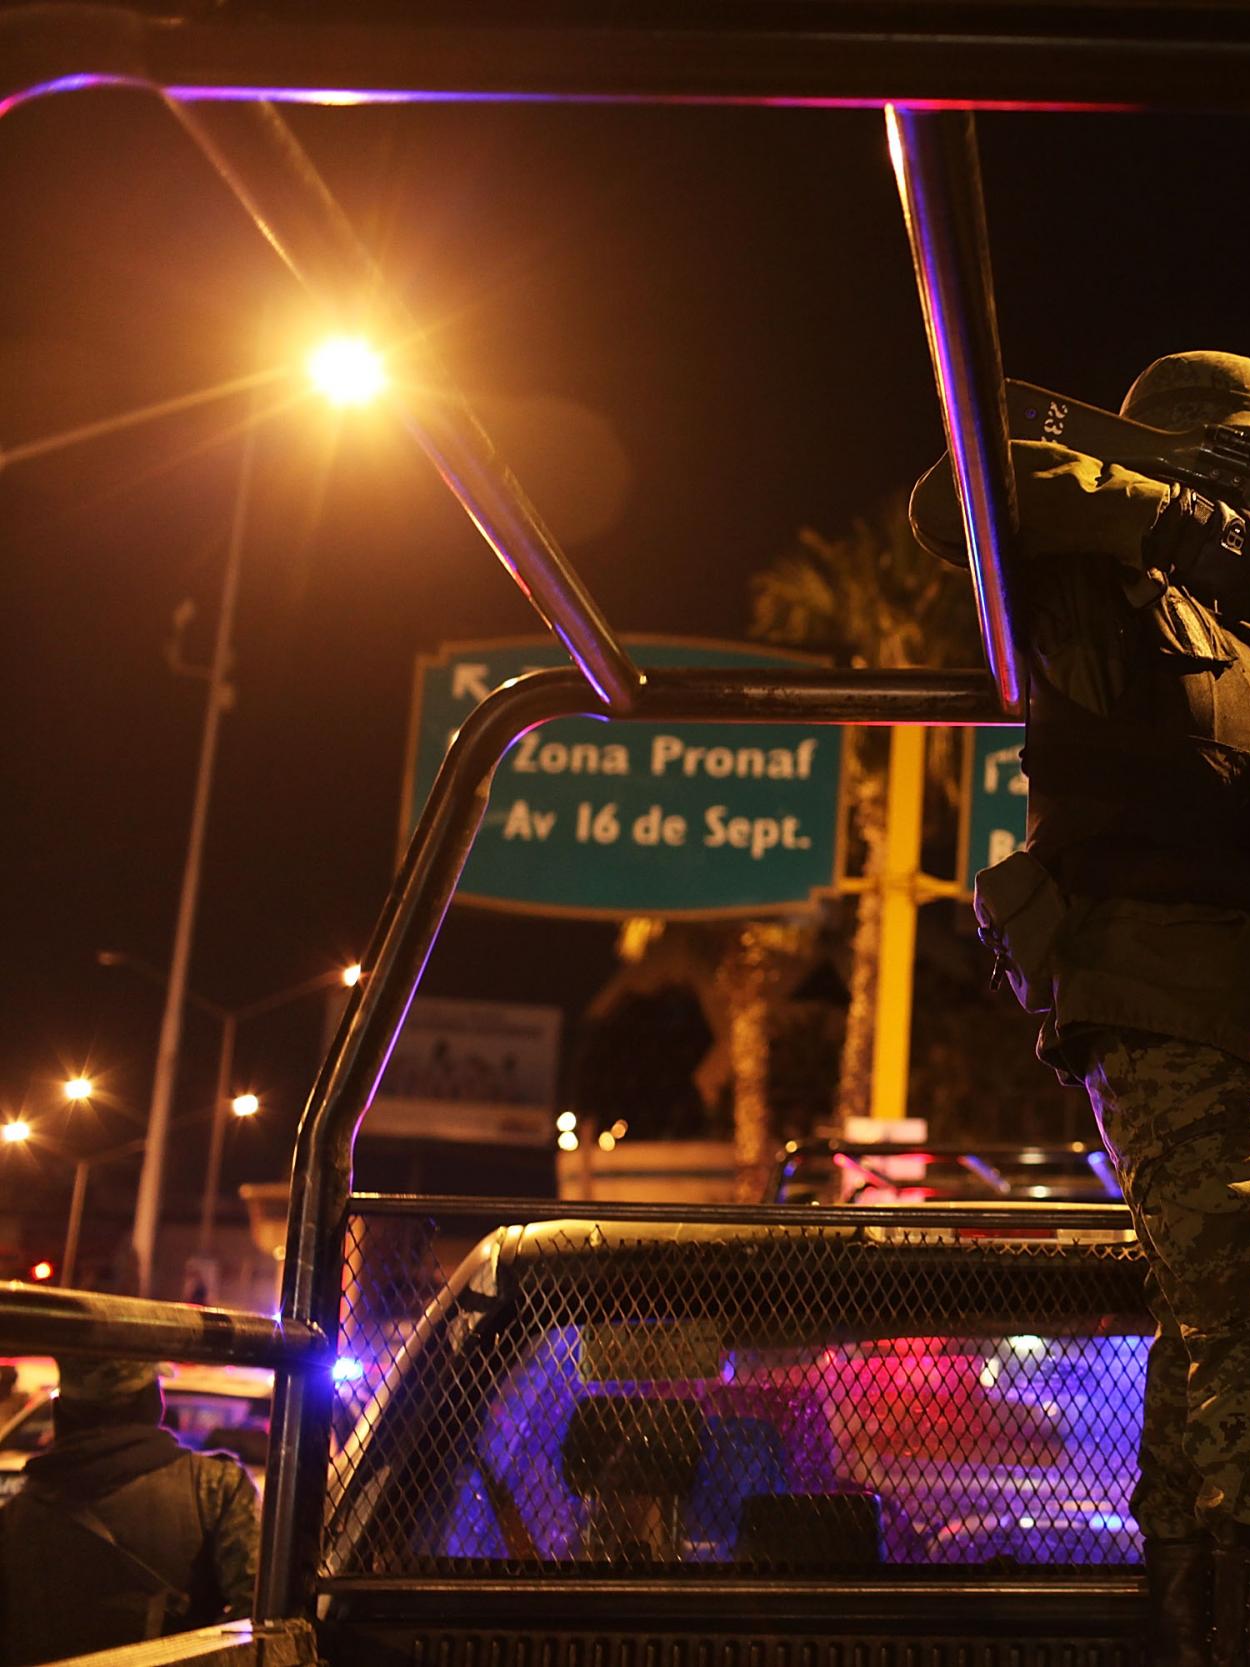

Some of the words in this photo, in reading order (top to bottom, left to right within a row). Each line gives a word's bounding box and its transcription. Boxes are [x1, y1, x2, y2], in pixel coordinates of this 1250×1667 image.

[1041, 401, 1068, 443] 23
[513, 732, 630, 776] Zona
[651, 735, 818, 780] Pronaf
[503, 800, 556, 841] Av
[576, 801, 621, 845] 16
[632, 805, 687, 847] de
[703, 805, 812, 859] Sept.
